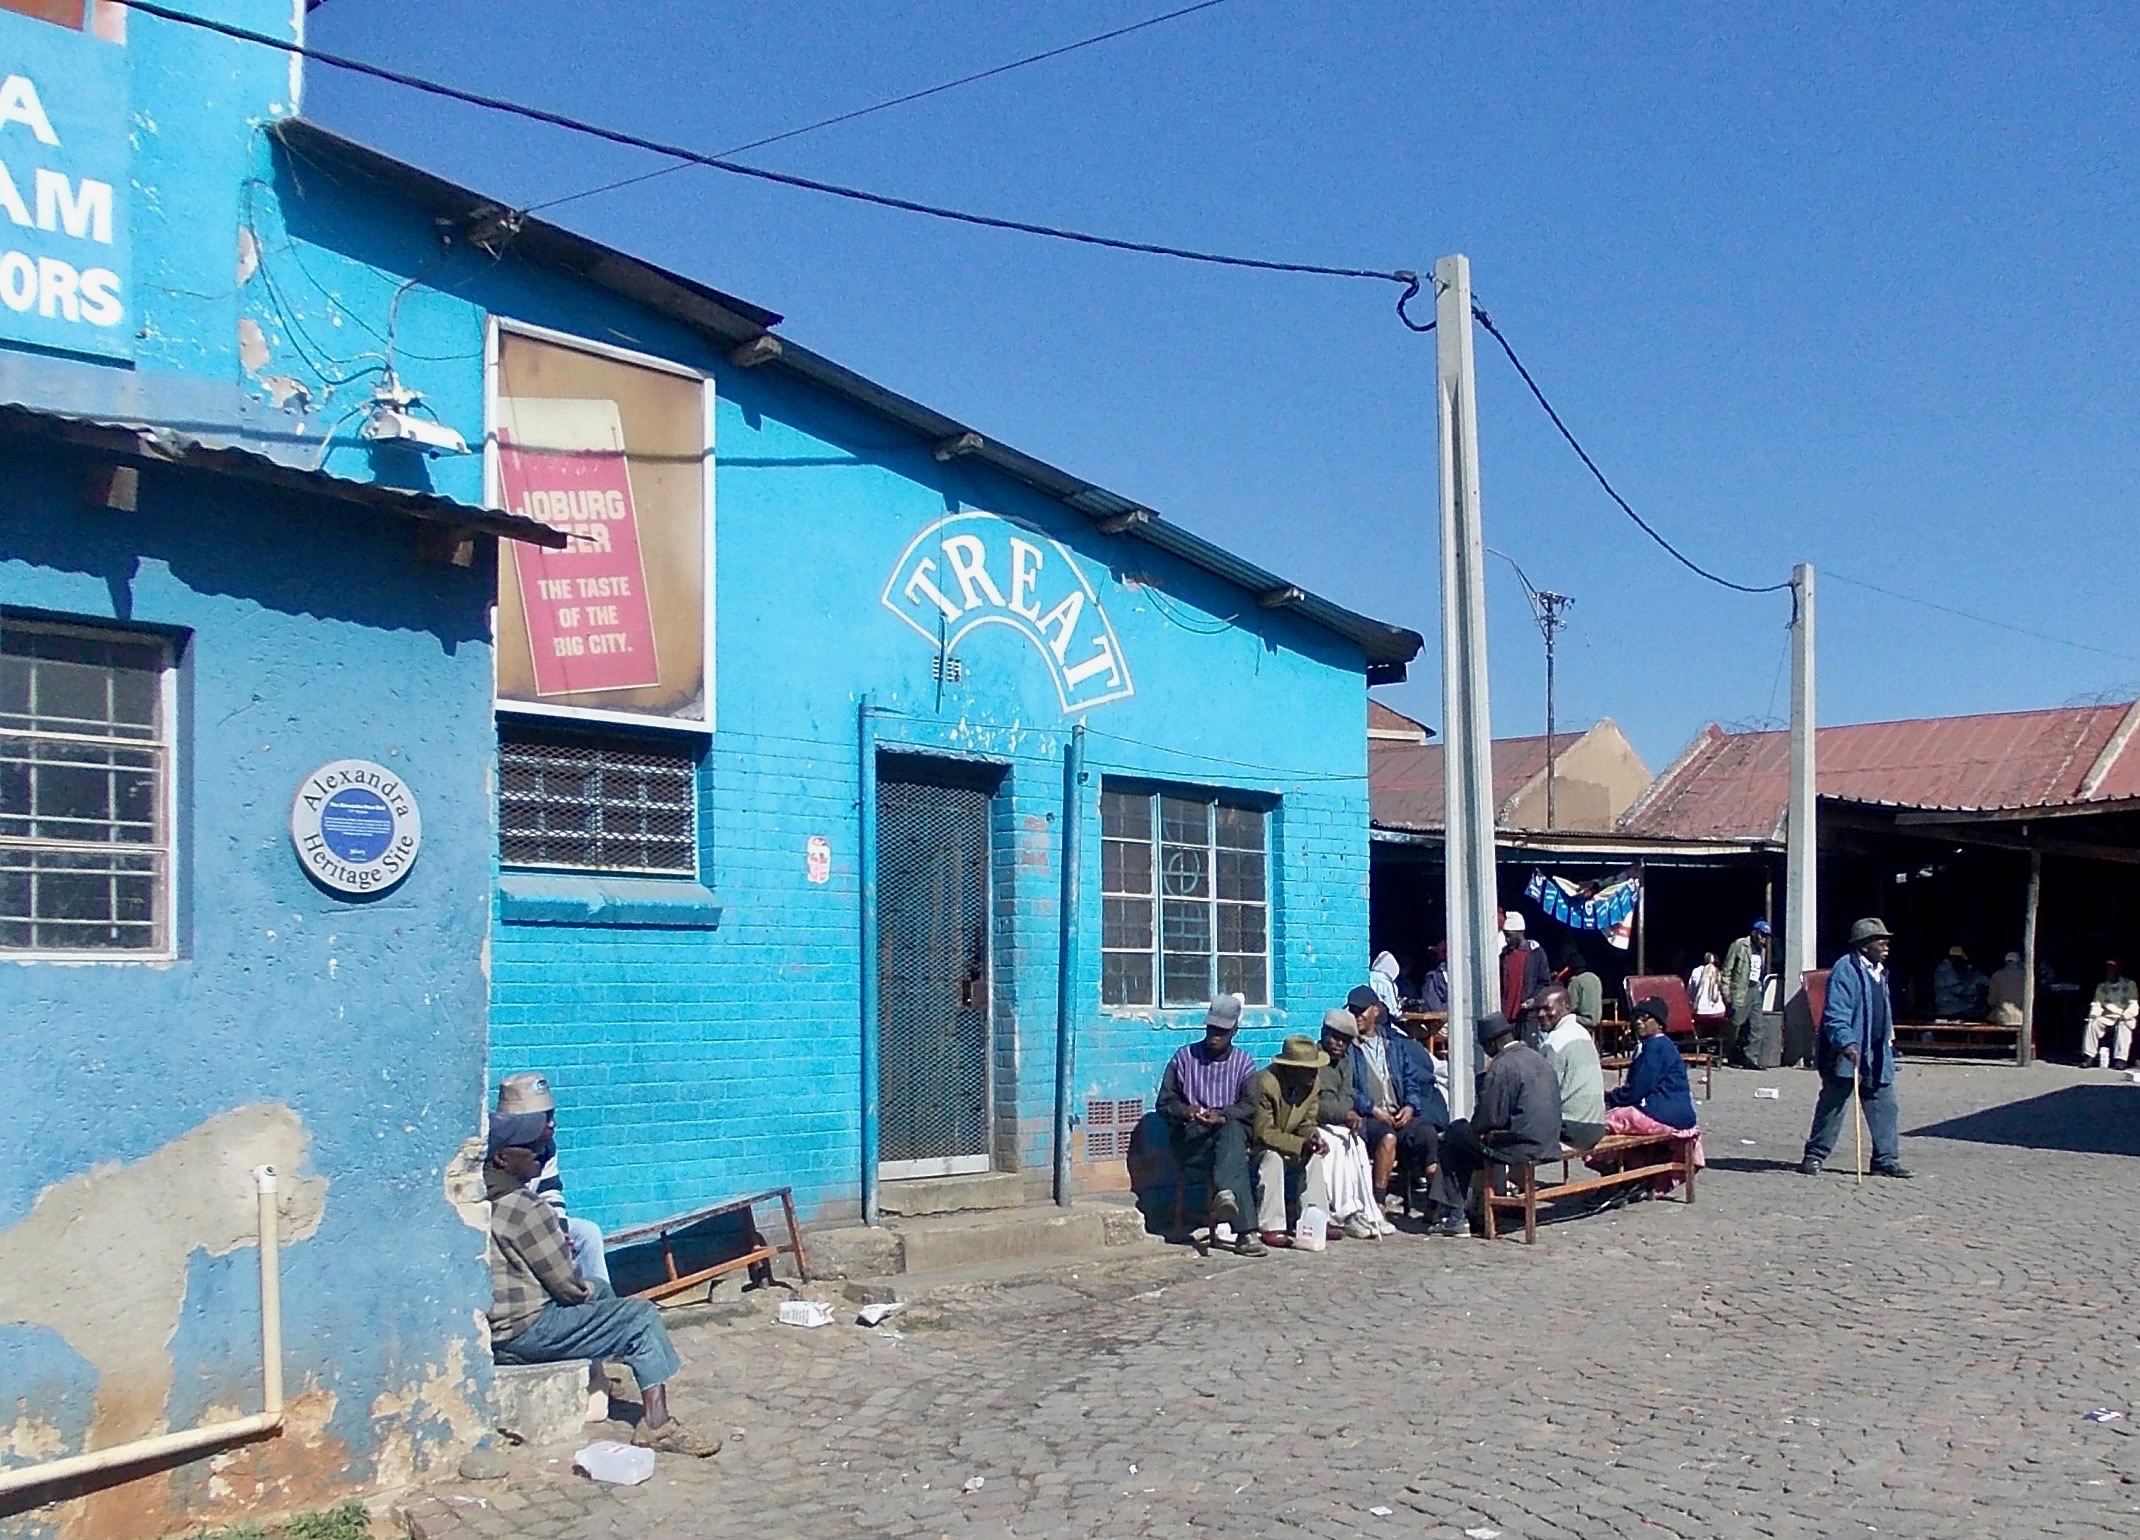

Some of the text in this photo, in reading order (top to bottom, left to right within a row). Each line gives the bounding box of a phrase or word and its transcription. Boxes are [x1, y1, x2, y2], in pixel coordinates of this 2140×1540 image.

[0, 251, 123, 328] ORS
[516, 490, 626, 521] JOBURG
[541, 523, 612, 555] EER
[537, 576, 631, 601] THE TASTE
[559, 605, 620, 628] OF THE
[904, 534, 1121, 692] TREAT
[553, 633, 633, 657] BIG CITY.
[303, 769, 410, 818] Alexandra
[303, 833, 414, 890] Heritage Site
